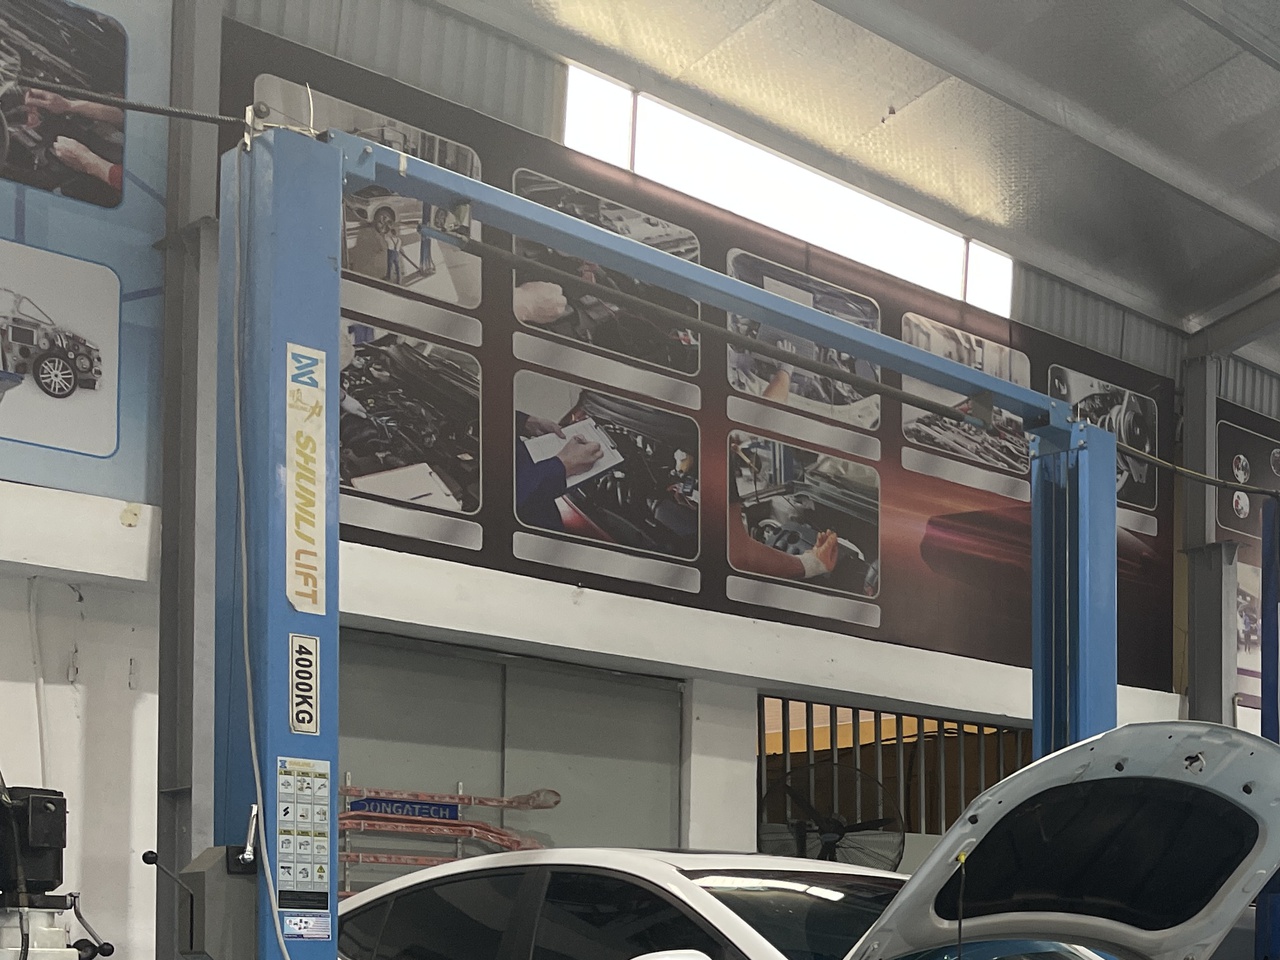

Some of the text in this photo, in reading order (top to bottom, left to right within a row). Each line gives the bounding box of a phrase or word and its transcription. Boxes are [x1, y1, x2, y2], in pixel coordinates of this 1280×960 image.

[295, 430, 317, 545] SHUNLI
[295, 548, 318, 605] LIFT
[294, 643, 314, 726] 4000KG
